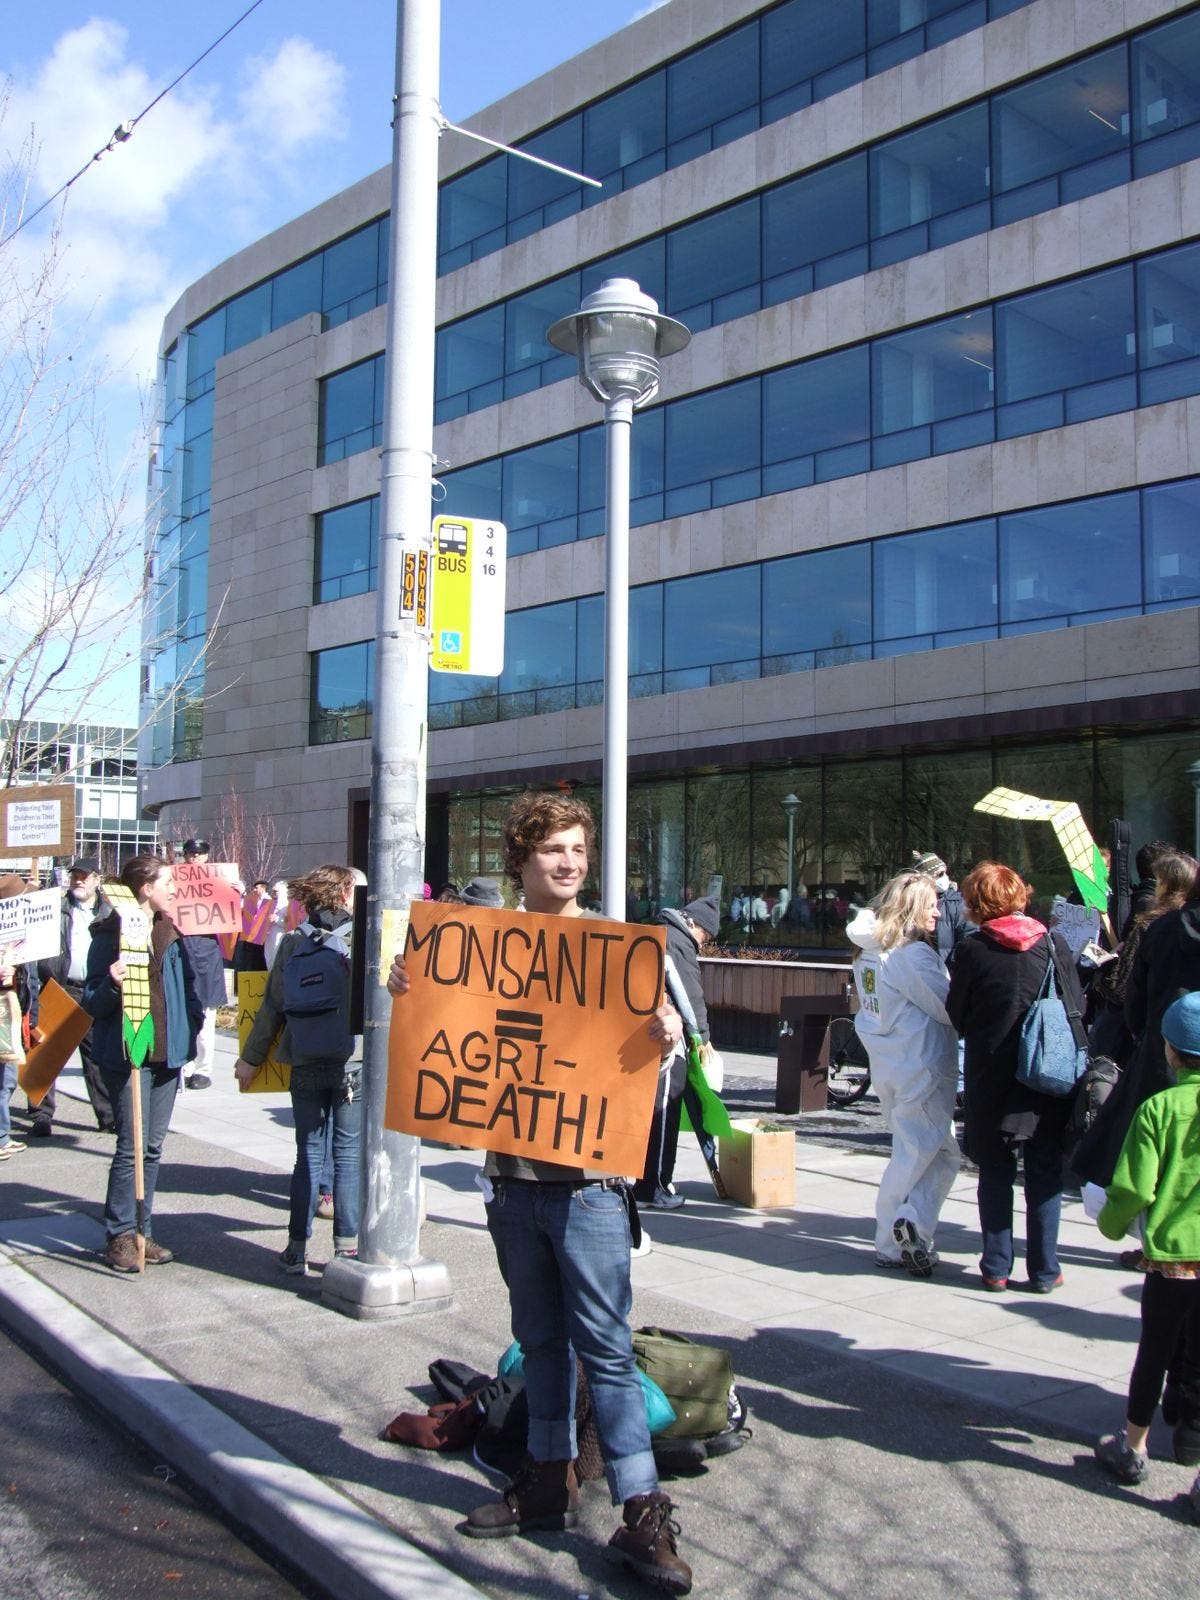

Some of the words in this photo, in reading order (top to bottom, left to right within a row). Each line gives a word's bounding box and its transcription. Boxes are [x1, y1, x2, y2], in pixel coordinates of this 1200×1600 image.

[485, 546, 494, 557] 4
[486, 527, 494, 539] 3
[403, 554, 416, 610] 504
[417, 550, 428, 626] 504B
[438, 557, 467, 573] BUS
[482, 564, 496, 576] 16
[403, 921, 664, 1016] MONSANTO
[421, 1028, 577, 1086] AGRI-
[413, 1068, 609, 1161] DEATH!
